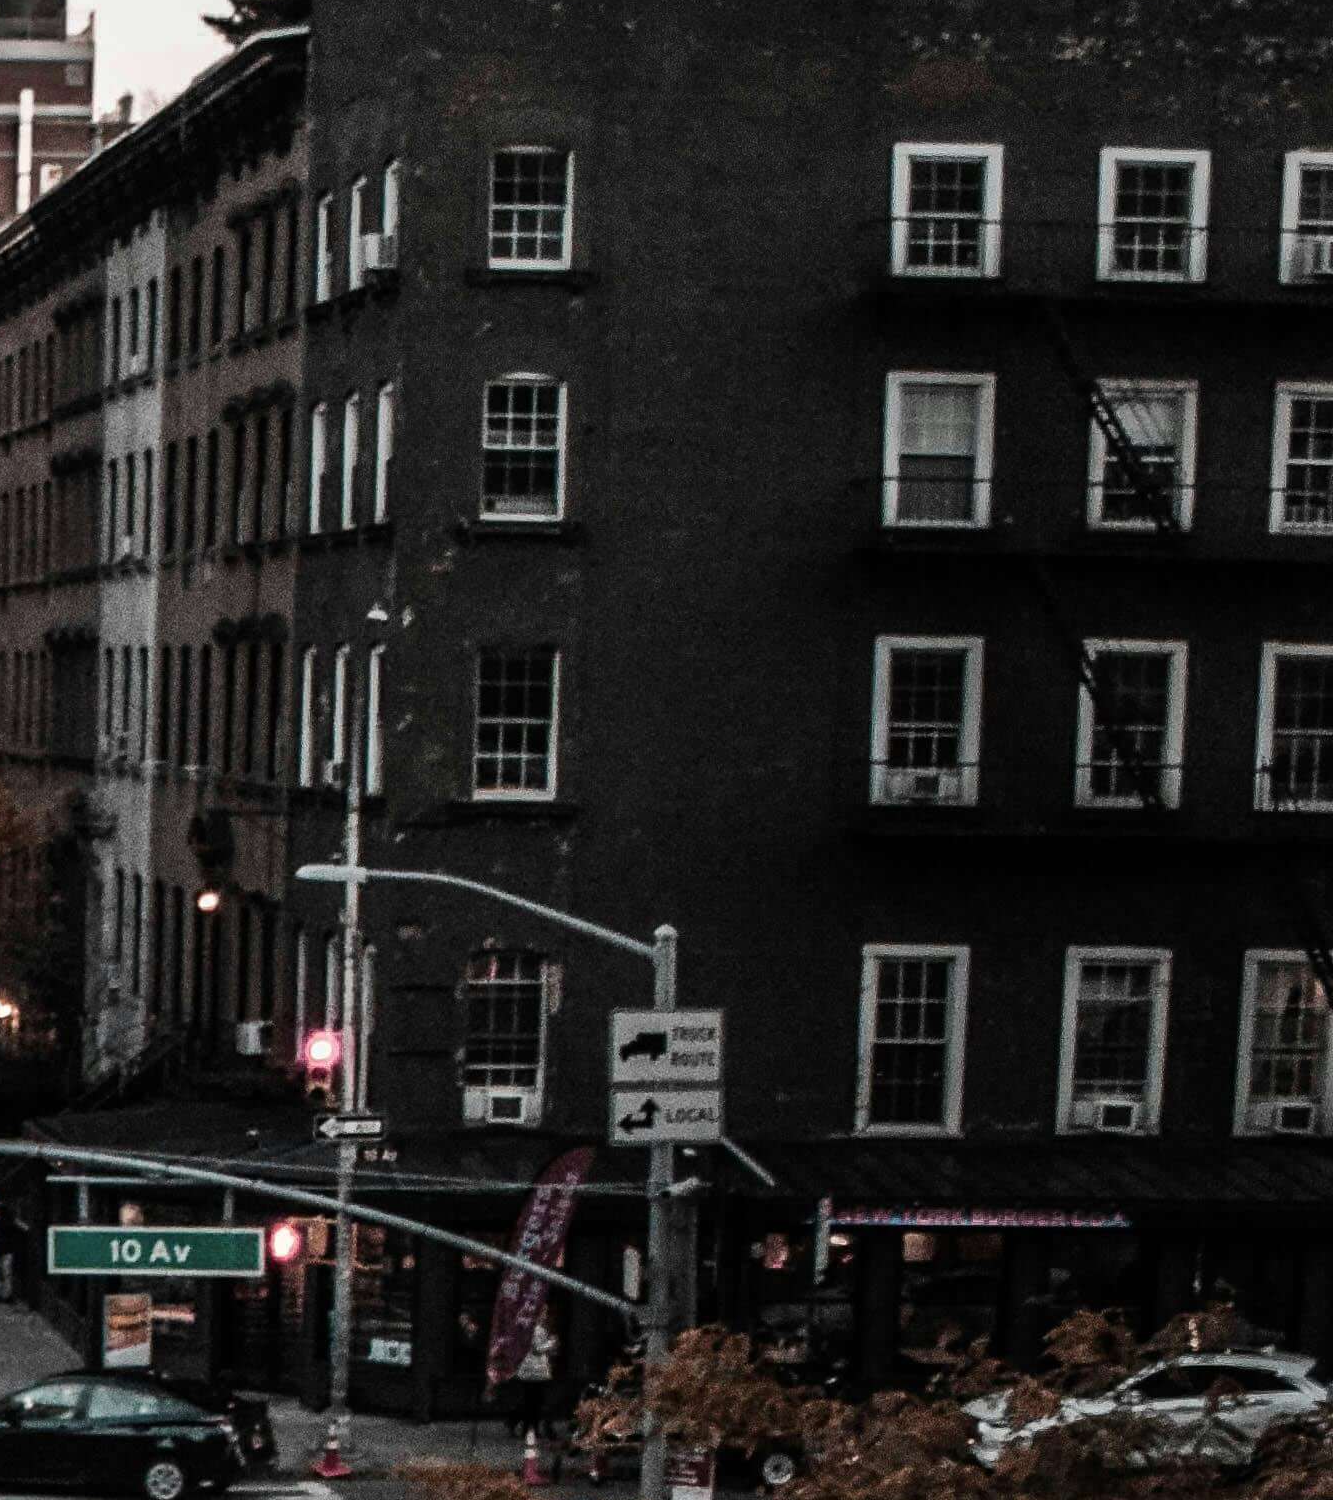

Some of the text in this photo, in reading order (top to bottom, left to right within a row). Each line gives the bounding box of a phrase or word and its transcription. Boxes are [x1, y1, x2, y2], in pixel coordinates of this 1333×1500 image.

[671, 1026, 717, 1042] TRUCK
[670, 1051, 717, 1067] ROUTE
[665, 1107, 719, 1124] LOCAL
[109, 1238, 192, 1263] 10 Av
